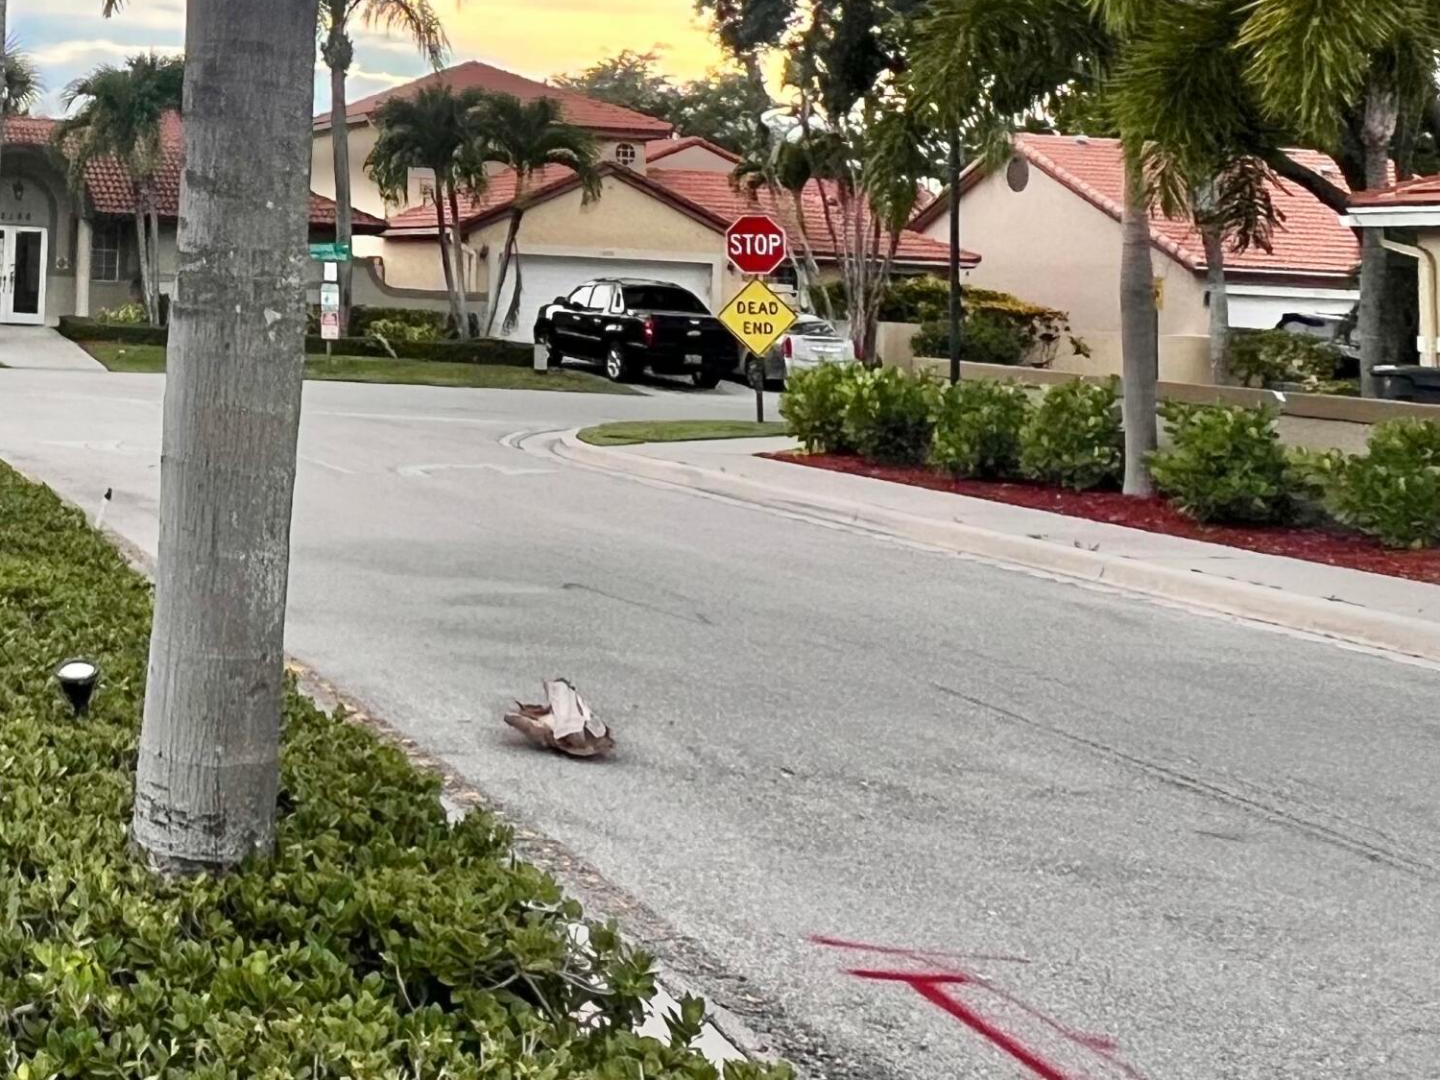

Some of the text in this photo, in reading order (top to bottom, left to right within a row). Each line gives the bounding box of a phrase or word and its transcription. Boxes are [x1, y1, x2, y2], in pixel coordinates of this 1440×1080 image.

[730, 233, 781, 256] STOP
[736, 301, 778, 315] DEAD
[743, 322, 773, 335] END
